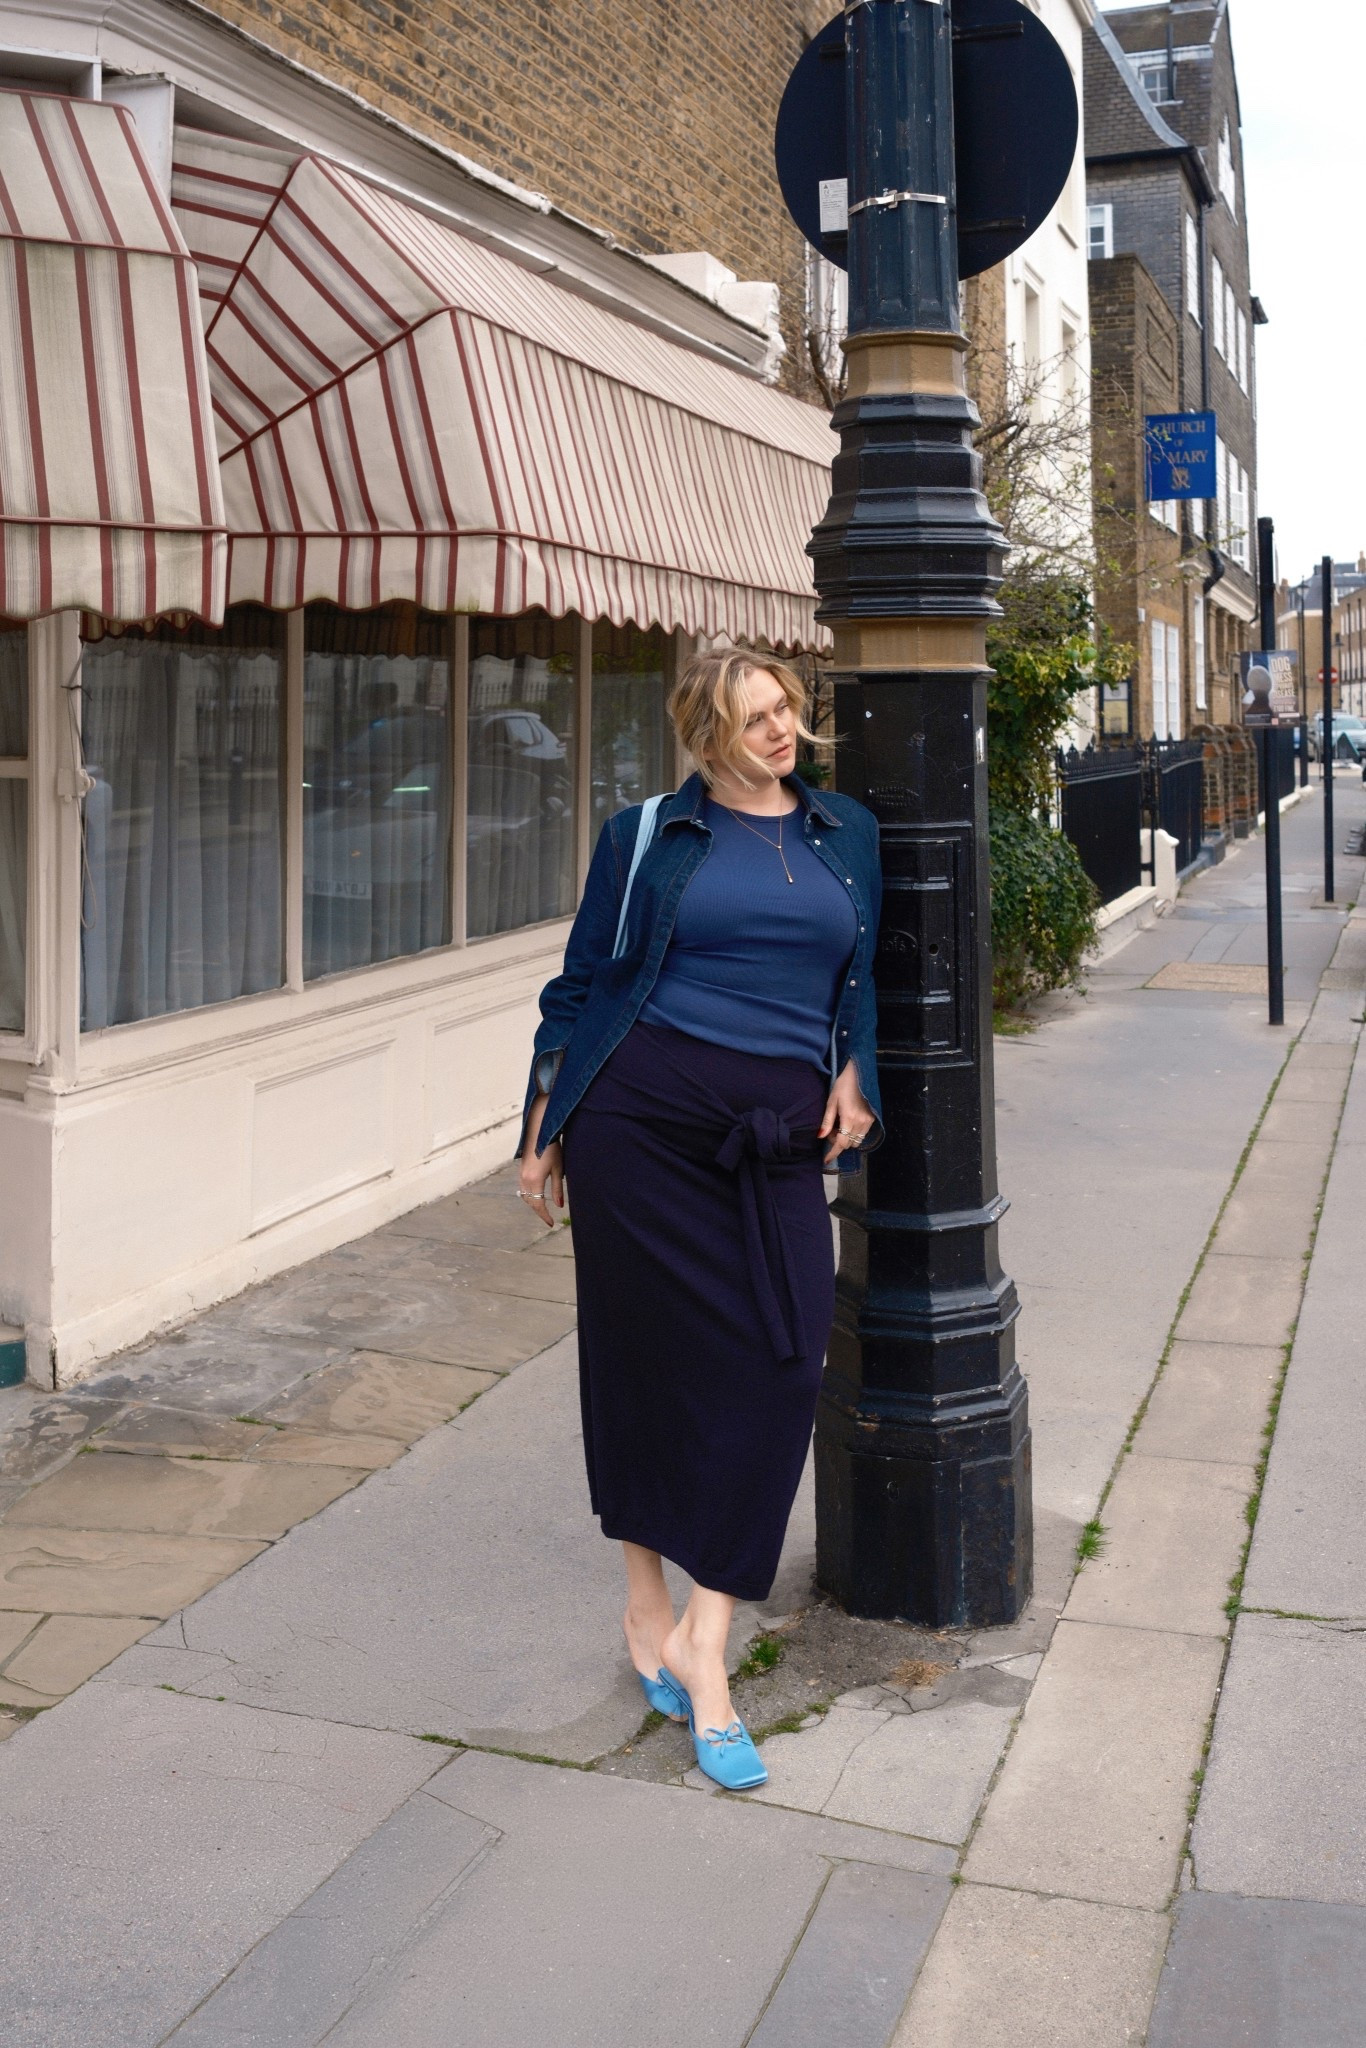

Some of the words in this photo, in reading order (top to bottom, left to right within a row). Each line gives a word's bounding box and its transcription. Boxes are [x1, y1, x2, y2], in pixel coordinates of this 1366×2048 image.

[1154, 421, 1206, 435] CHURCH
[1168, 450, 1208, 465] MARY
[1271, 656, 1291, 673] DOG
